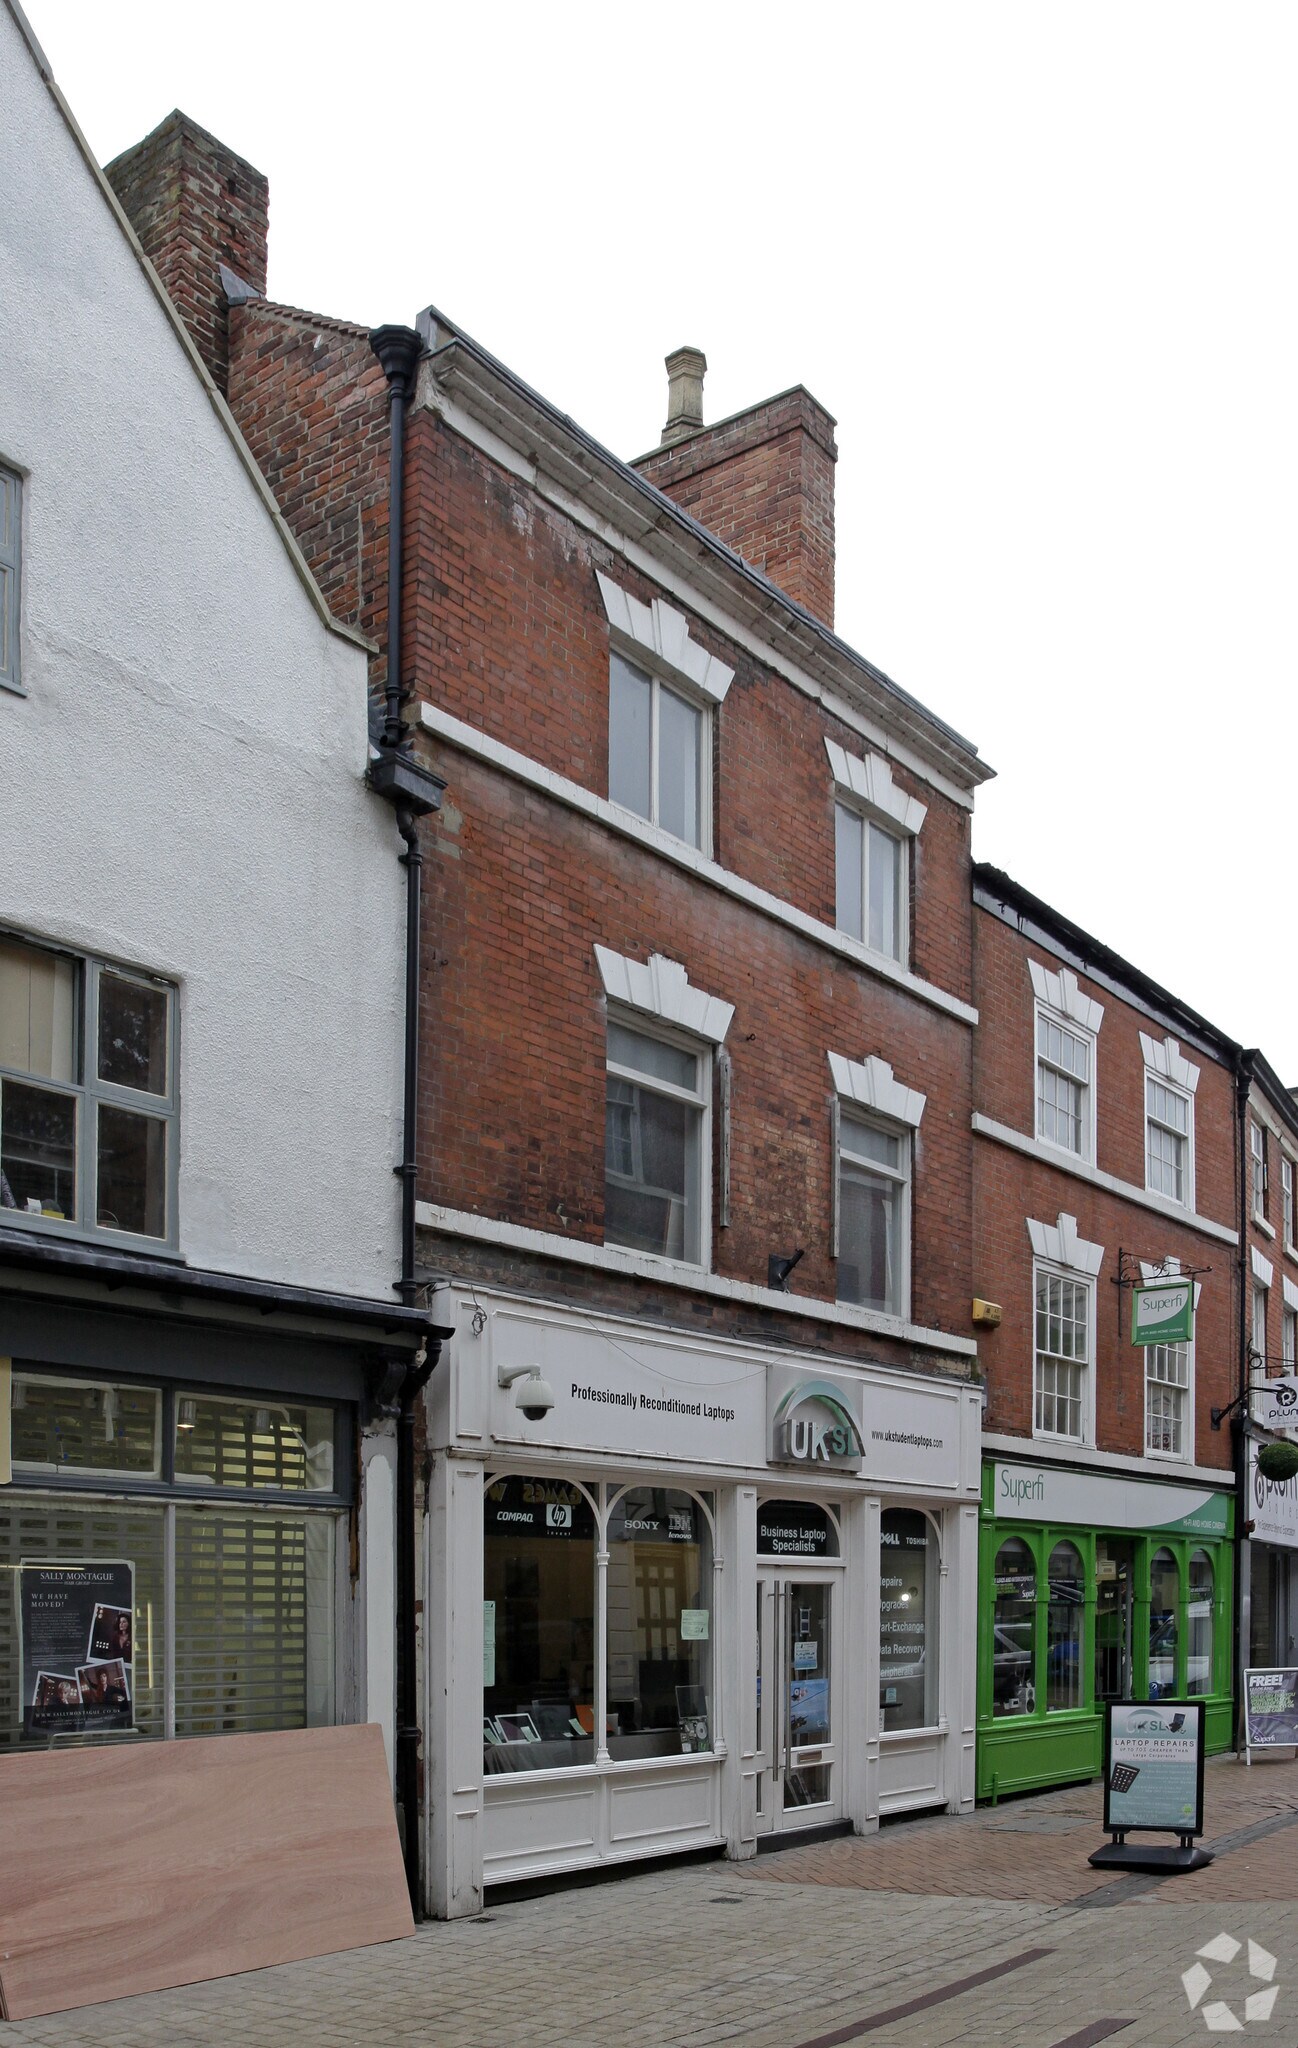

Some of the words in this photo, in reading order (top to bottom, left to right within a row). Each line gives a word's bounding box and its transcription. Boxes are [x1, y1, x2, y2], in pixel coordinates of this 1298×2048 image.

[1142, 1293, 1183, 1312] Superfi
[571, 1383, 637, 1410] Professionally
[640, 1394, 701, 1416] Reconditioned
[703, 1403, 735, 1422] Laptops
[786, 1418, 860, 1462] UKSL
[871, 1429, 943, 1450] www.ukstudentlaptops.com
[1001, 1469, 1044, 1506] Superfi
[496, 1511, 534, 1523] COMPAQ
[668, 1514, 692, 1531] IBM
[624, 1519, 660, 1530] SONY
[668, 1531, 692, 1539] lenovo
[760, 1525, 798, 1538] Business
[799, 1527, 827, 1542] Laptop
[772, 1538, 816, 1553] Specialists
[905, 1537, 929, 1545] TOSHIBA
[40, 1572, 65, 1580] SALLY
[66, 1572, 114, 1581] MONTAGUE
[880, 1576, 903, 1588] epairs
[880, 1621, 924, 1634] art-Exchange
[880, 1644, 892, 1655] ata
[893, 1643, 924, 1655] Recovery
[880, 1666, 914, 1678] eripherals
[1249, 1674, 1283, 1687] FREE!
